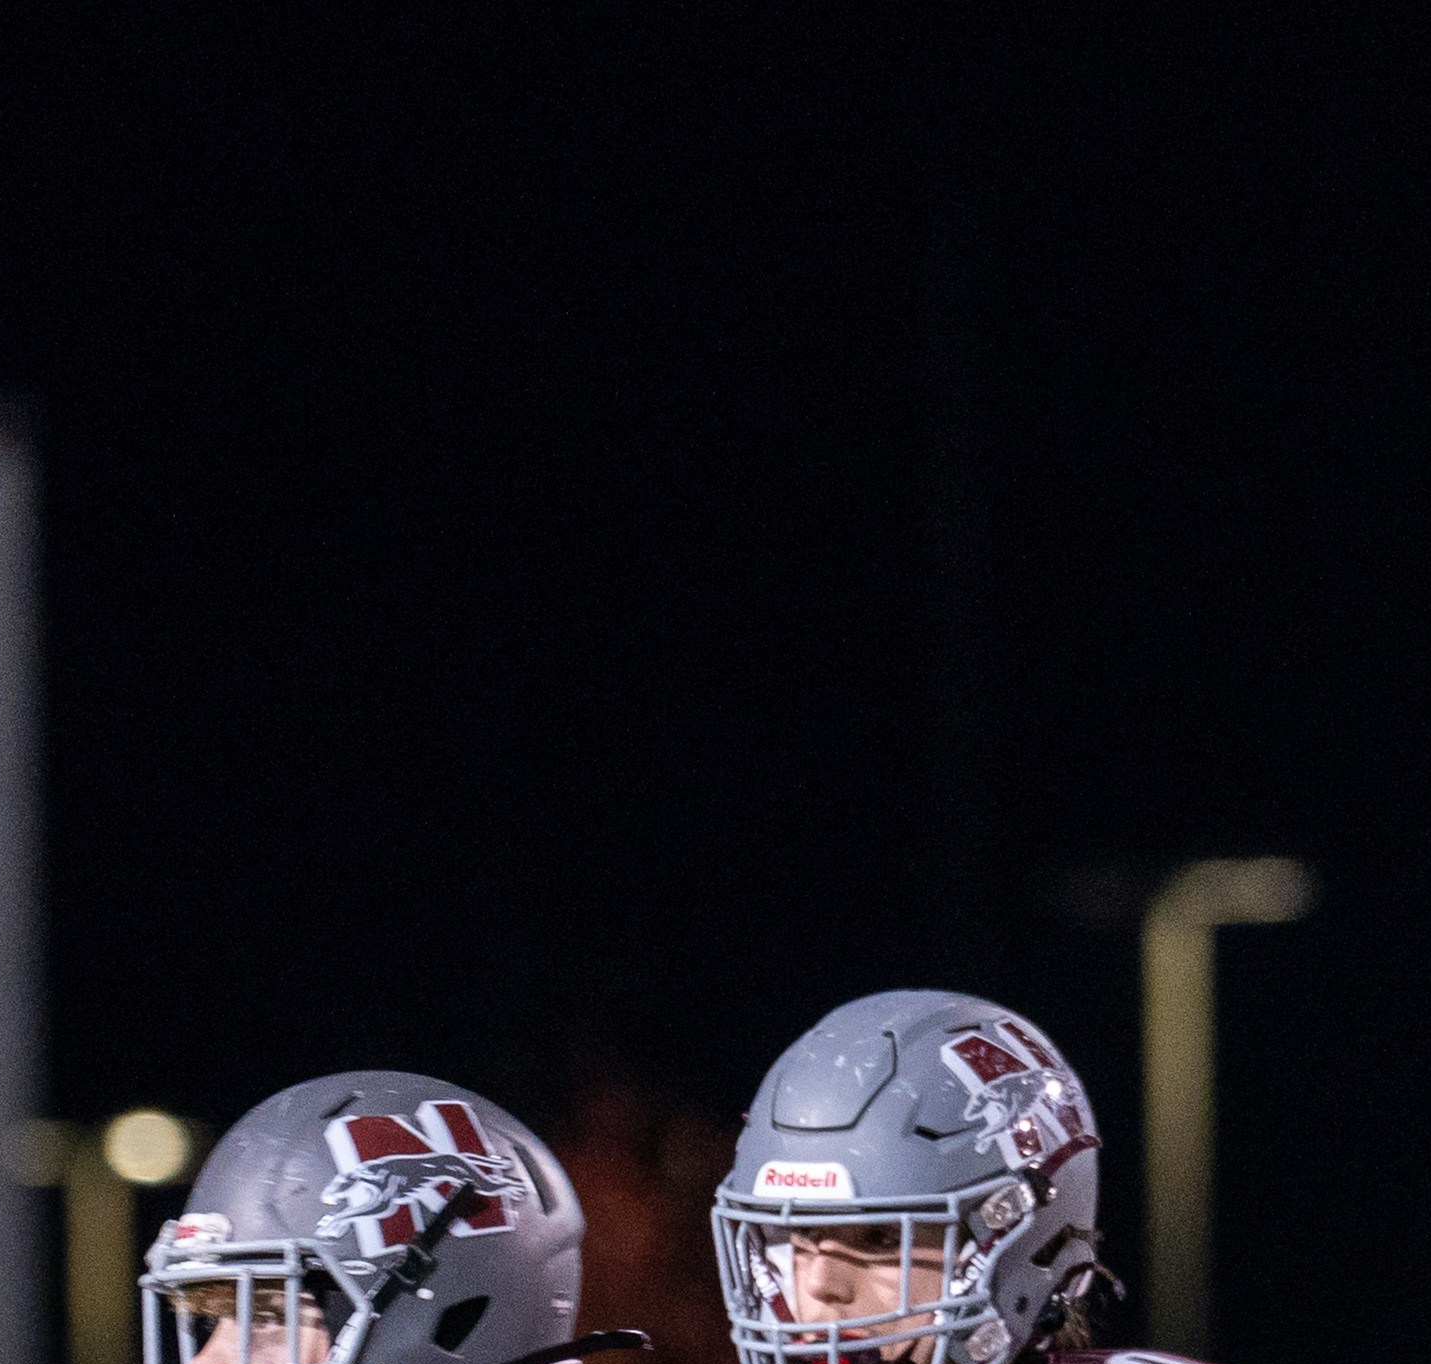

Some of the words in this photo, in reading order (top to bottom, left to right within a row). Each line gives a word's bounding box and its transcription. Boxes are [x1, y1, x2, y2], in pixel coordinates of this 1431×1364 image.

[939, 1017, 1091, 1170] N
[323, 1100, 516, 1258] N
[764, 1167, 838, 1188] Riddell
